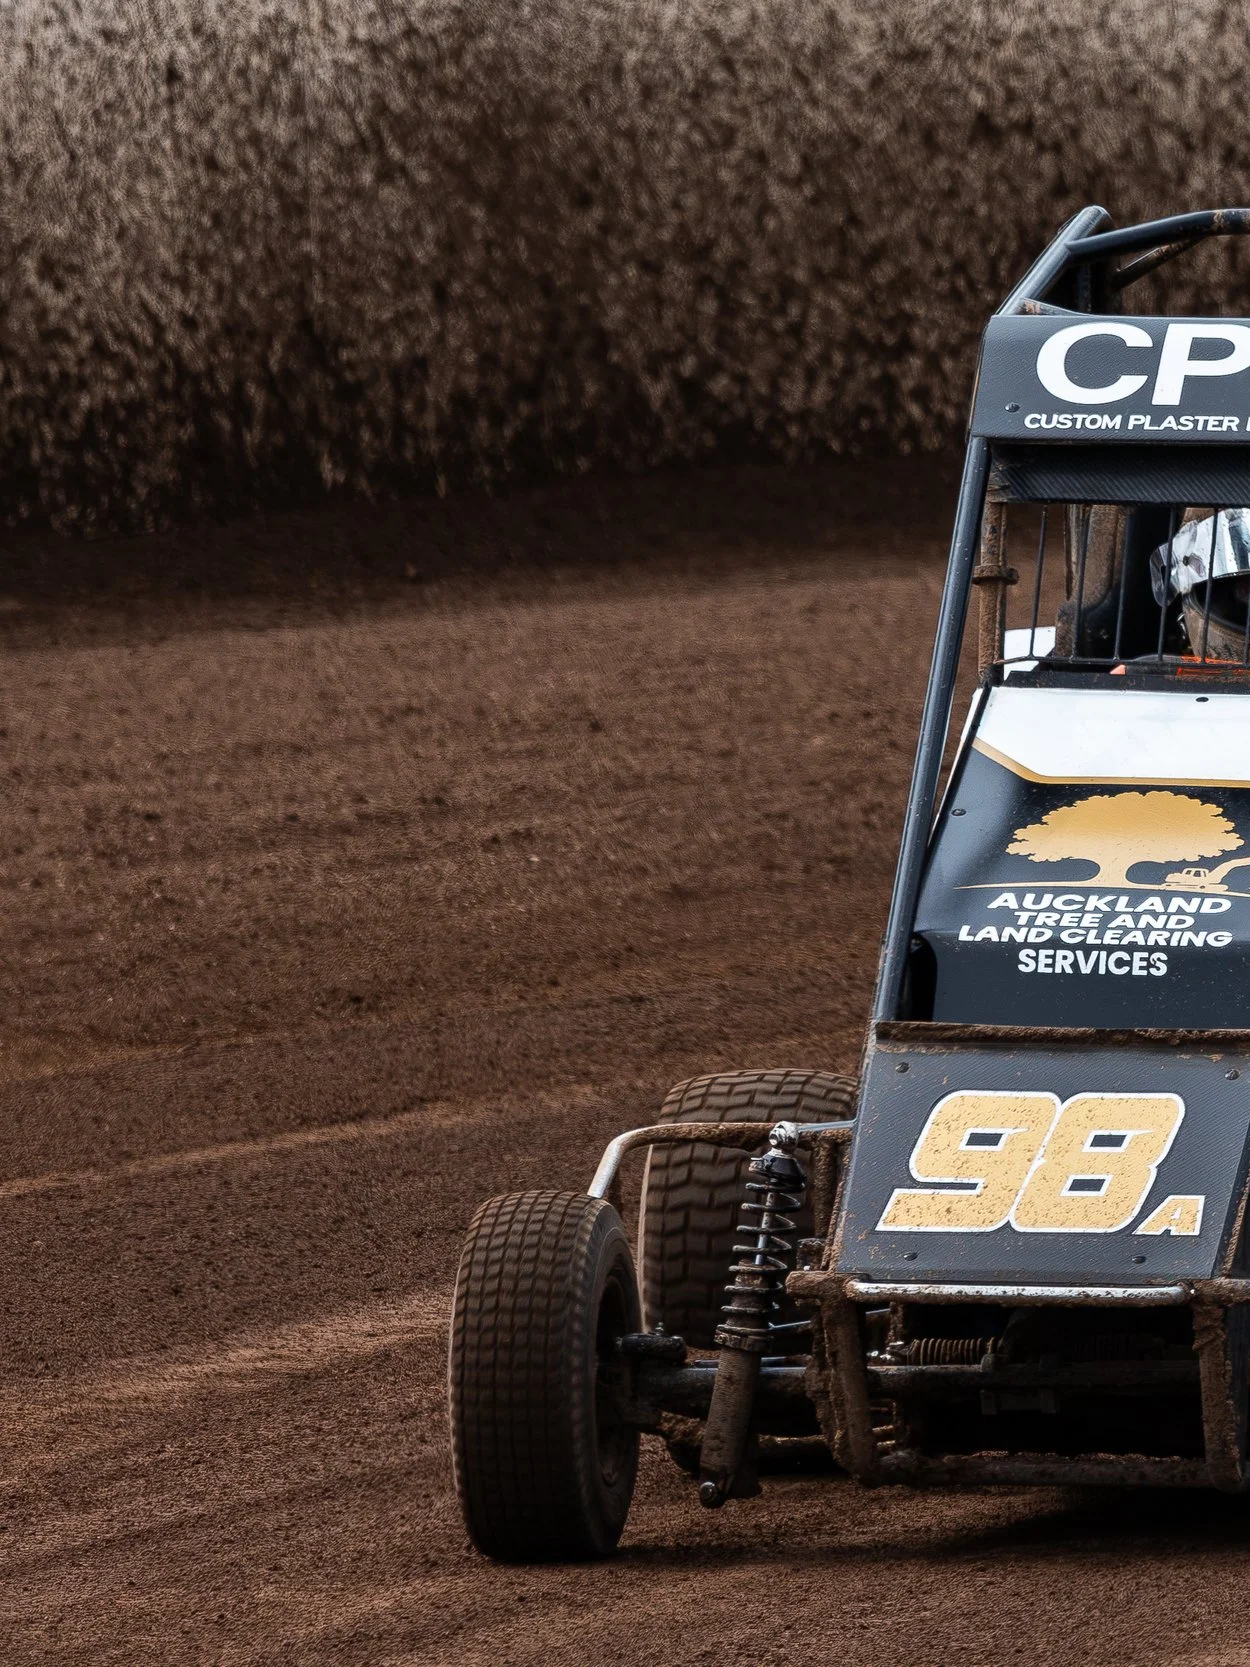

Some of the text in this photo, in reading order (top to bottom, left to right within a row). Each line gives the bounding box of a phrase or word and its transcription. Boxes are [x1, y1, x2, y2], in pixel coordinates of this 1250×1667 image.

[1023, 413, 1121, 430] CUSTOM
[1127, 414, 1238, 432] PLASTER
[987, 892, 1232, 914] AUCKLAND
[1014, 911, 1195, 929] TREE AND
[958, 925, 1233, 947] LAND CLEARING
[1017, 949, 1168, 977] SERVICES
